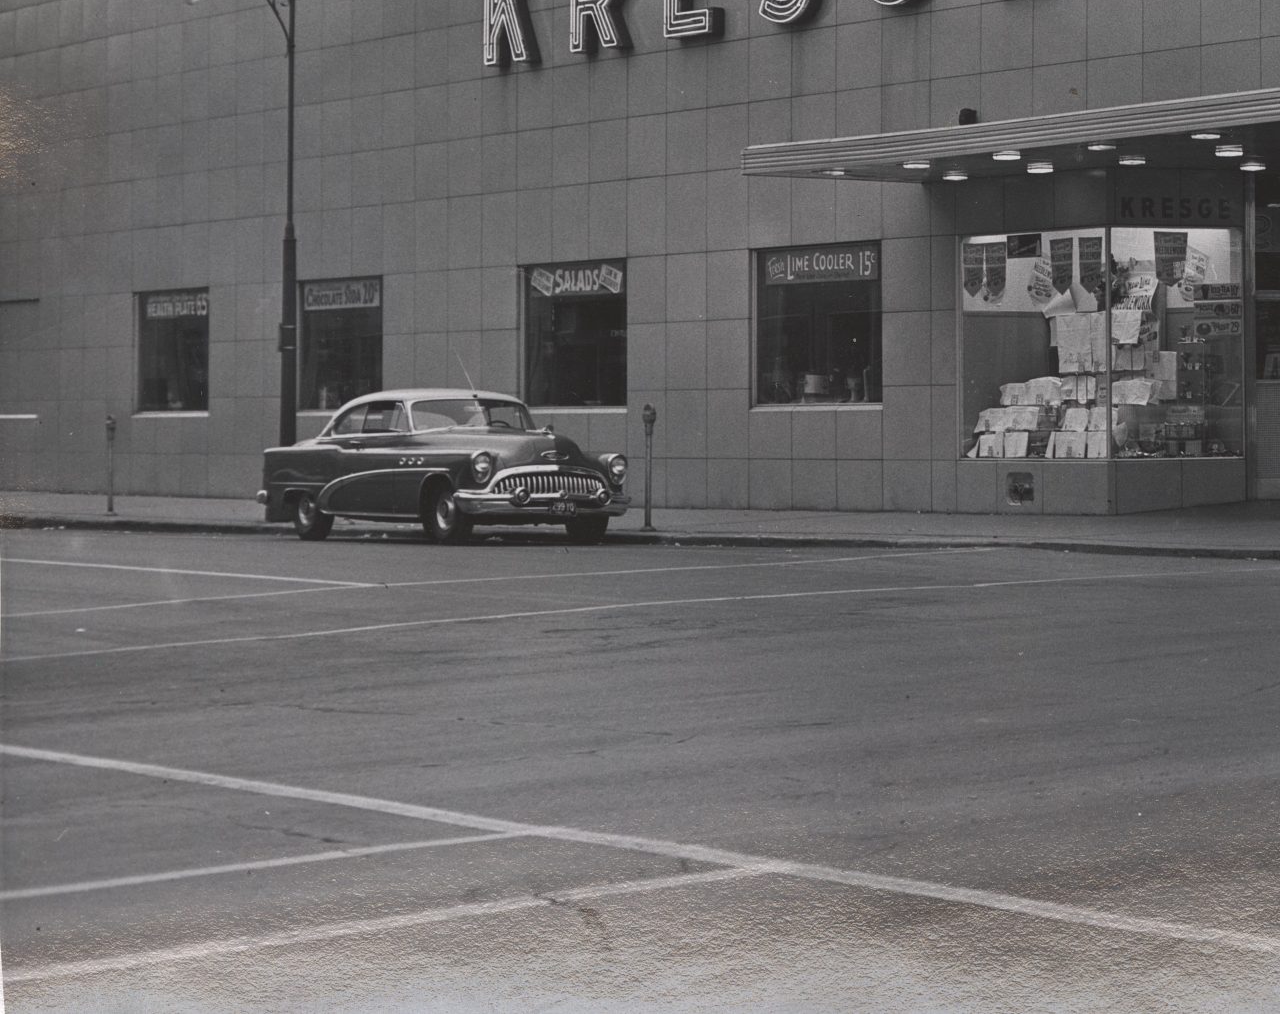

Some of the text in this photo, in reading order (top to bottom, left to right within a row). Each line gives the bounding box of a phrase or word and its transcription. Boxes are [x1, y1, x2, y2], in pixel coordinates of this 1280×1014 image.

[1120, 196, 1232, 219] KRESGE
[787, 254, 809, 280] LIME
[813, 252, 855, 271] COOLER
[555, 269, 599, 294] SALADS
